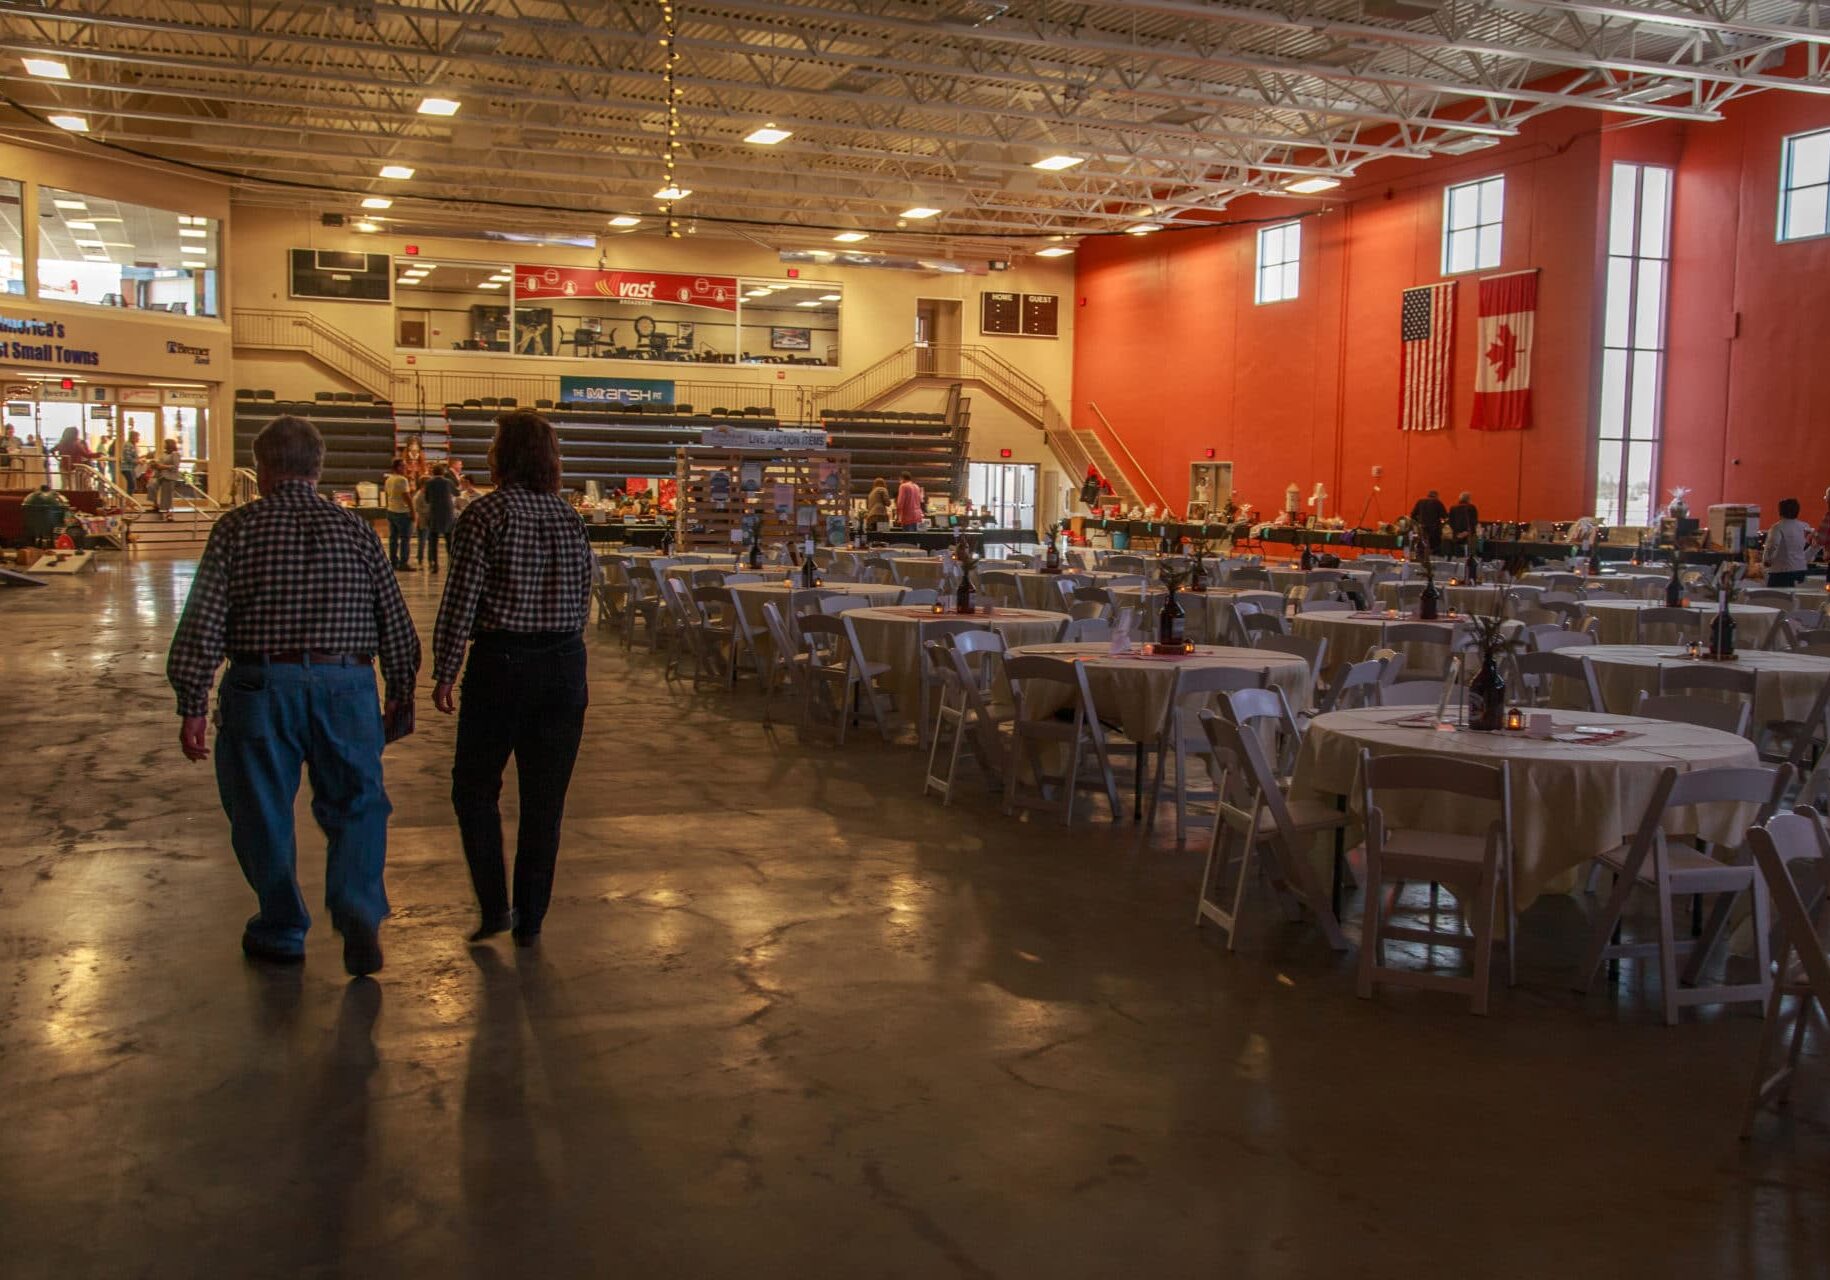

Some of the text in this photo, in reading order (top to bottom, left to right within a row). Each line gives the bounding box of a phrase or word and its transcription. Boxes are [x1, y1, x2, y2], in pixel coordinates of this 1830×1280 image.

[619, 281, 656, 298] vast
[992, 293, 1013, 301] HOME
[1028, 295, 1052, 303] GUEST
[12, 341, 53, 361] Small
[55, 345, 99, 365] Towns
[573, 388, 584, 398] THE
[767, 434, 800, 446] AUCTION
[802, 435, 825, 446] ITEMS
